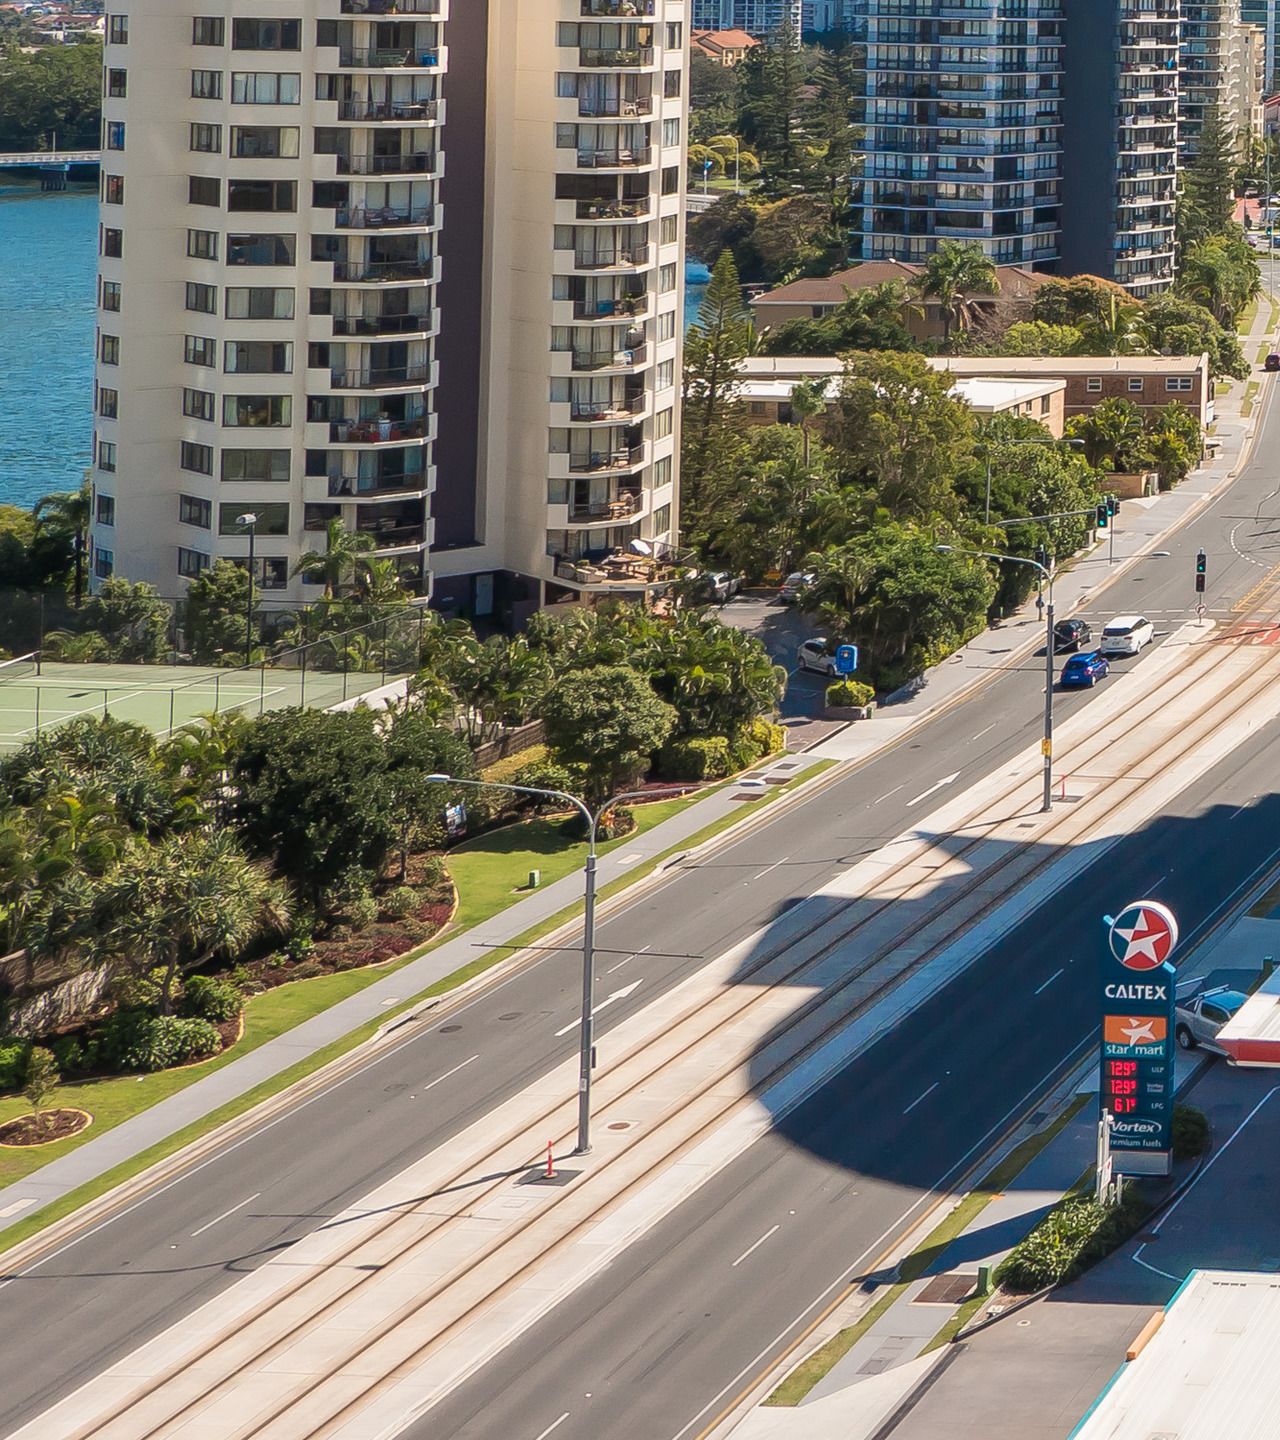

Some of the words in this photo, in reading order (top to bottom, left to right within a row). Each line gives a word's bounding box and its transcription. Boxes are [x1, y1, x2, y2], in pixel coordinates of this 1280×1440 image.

[1104, 984, 1167, 1000] CALTEX
[1106, 1044, 1129, 1055] star
[1135, 1045, 1164, 1055] mart
[1108, 1121, 1155, 1133] Vortex
[1110, 1139, 1140, 1147] remium
[1142, 1139, 1162, 1148] fuels
